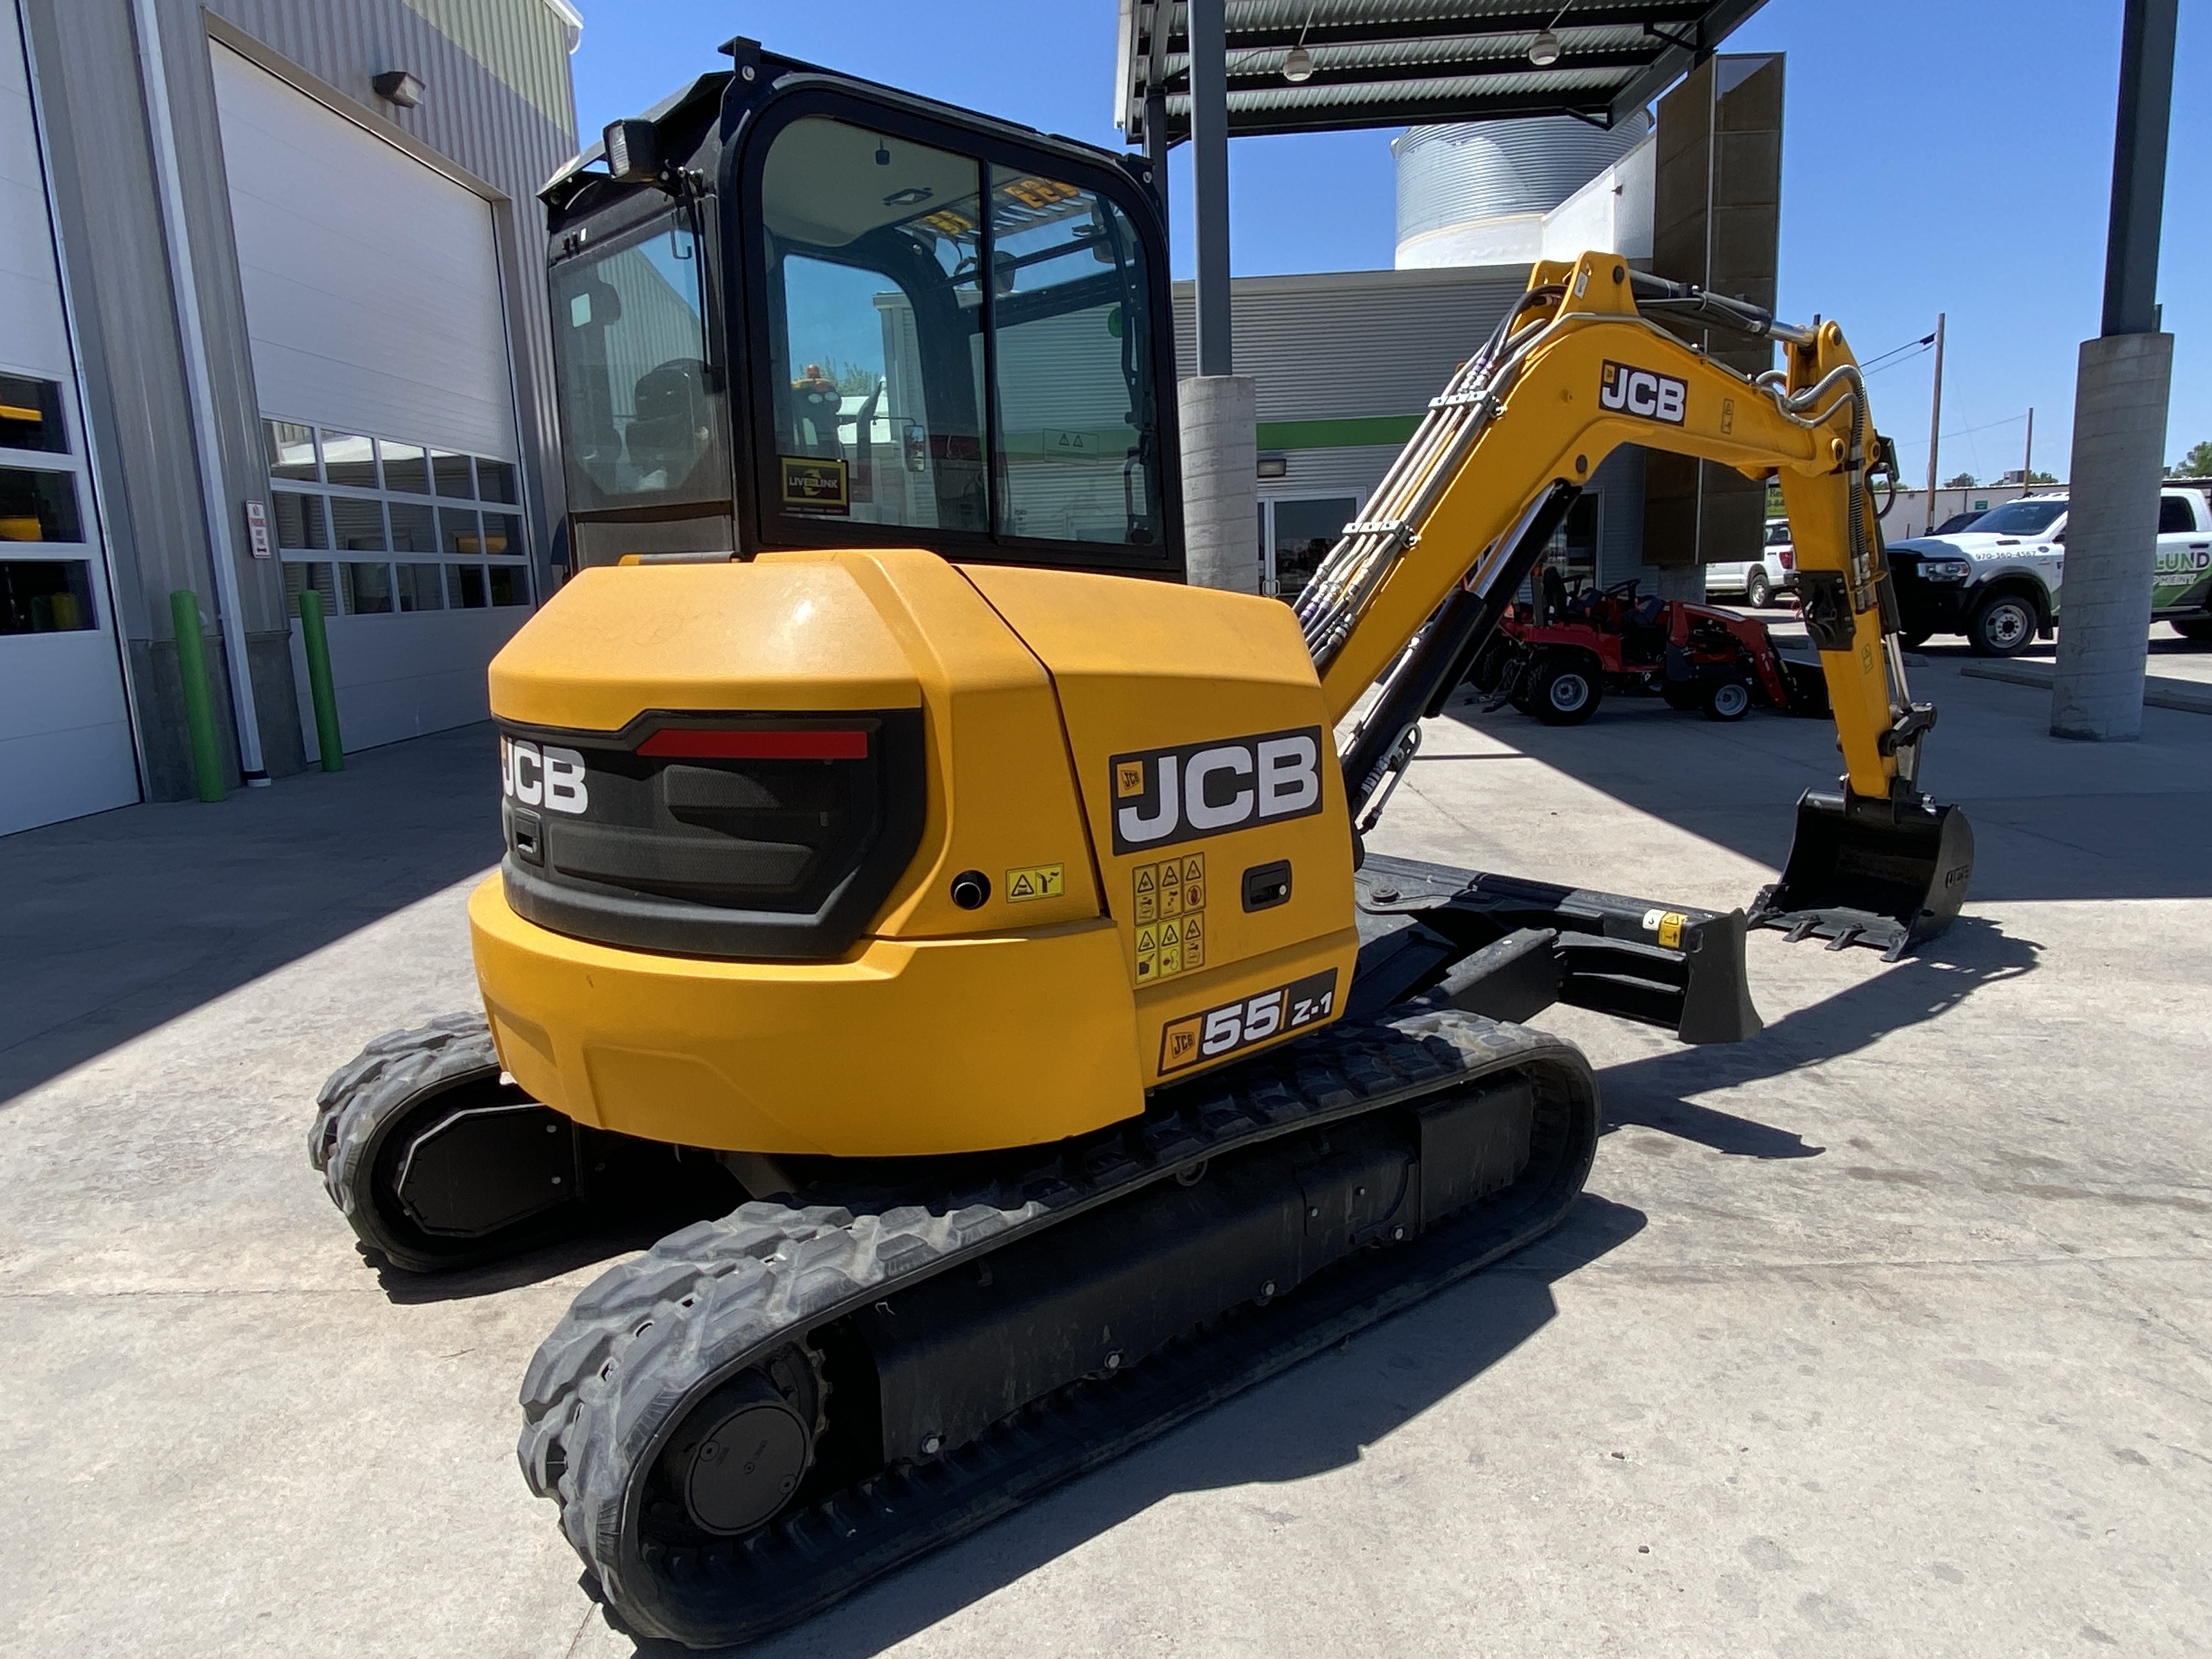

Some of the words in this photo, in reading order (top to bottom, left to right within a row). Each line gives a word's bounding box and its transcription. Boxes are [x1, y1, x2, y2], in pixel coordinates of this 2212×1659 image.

[1602, 368, 1686, 422] JCB
[503, 737, 588, 814] JCB
[1118, 736, 1319, 843] JCB
[1173, 1032, 1195, 1056] JCB
[1203, 991, 1282, 1055] 55
